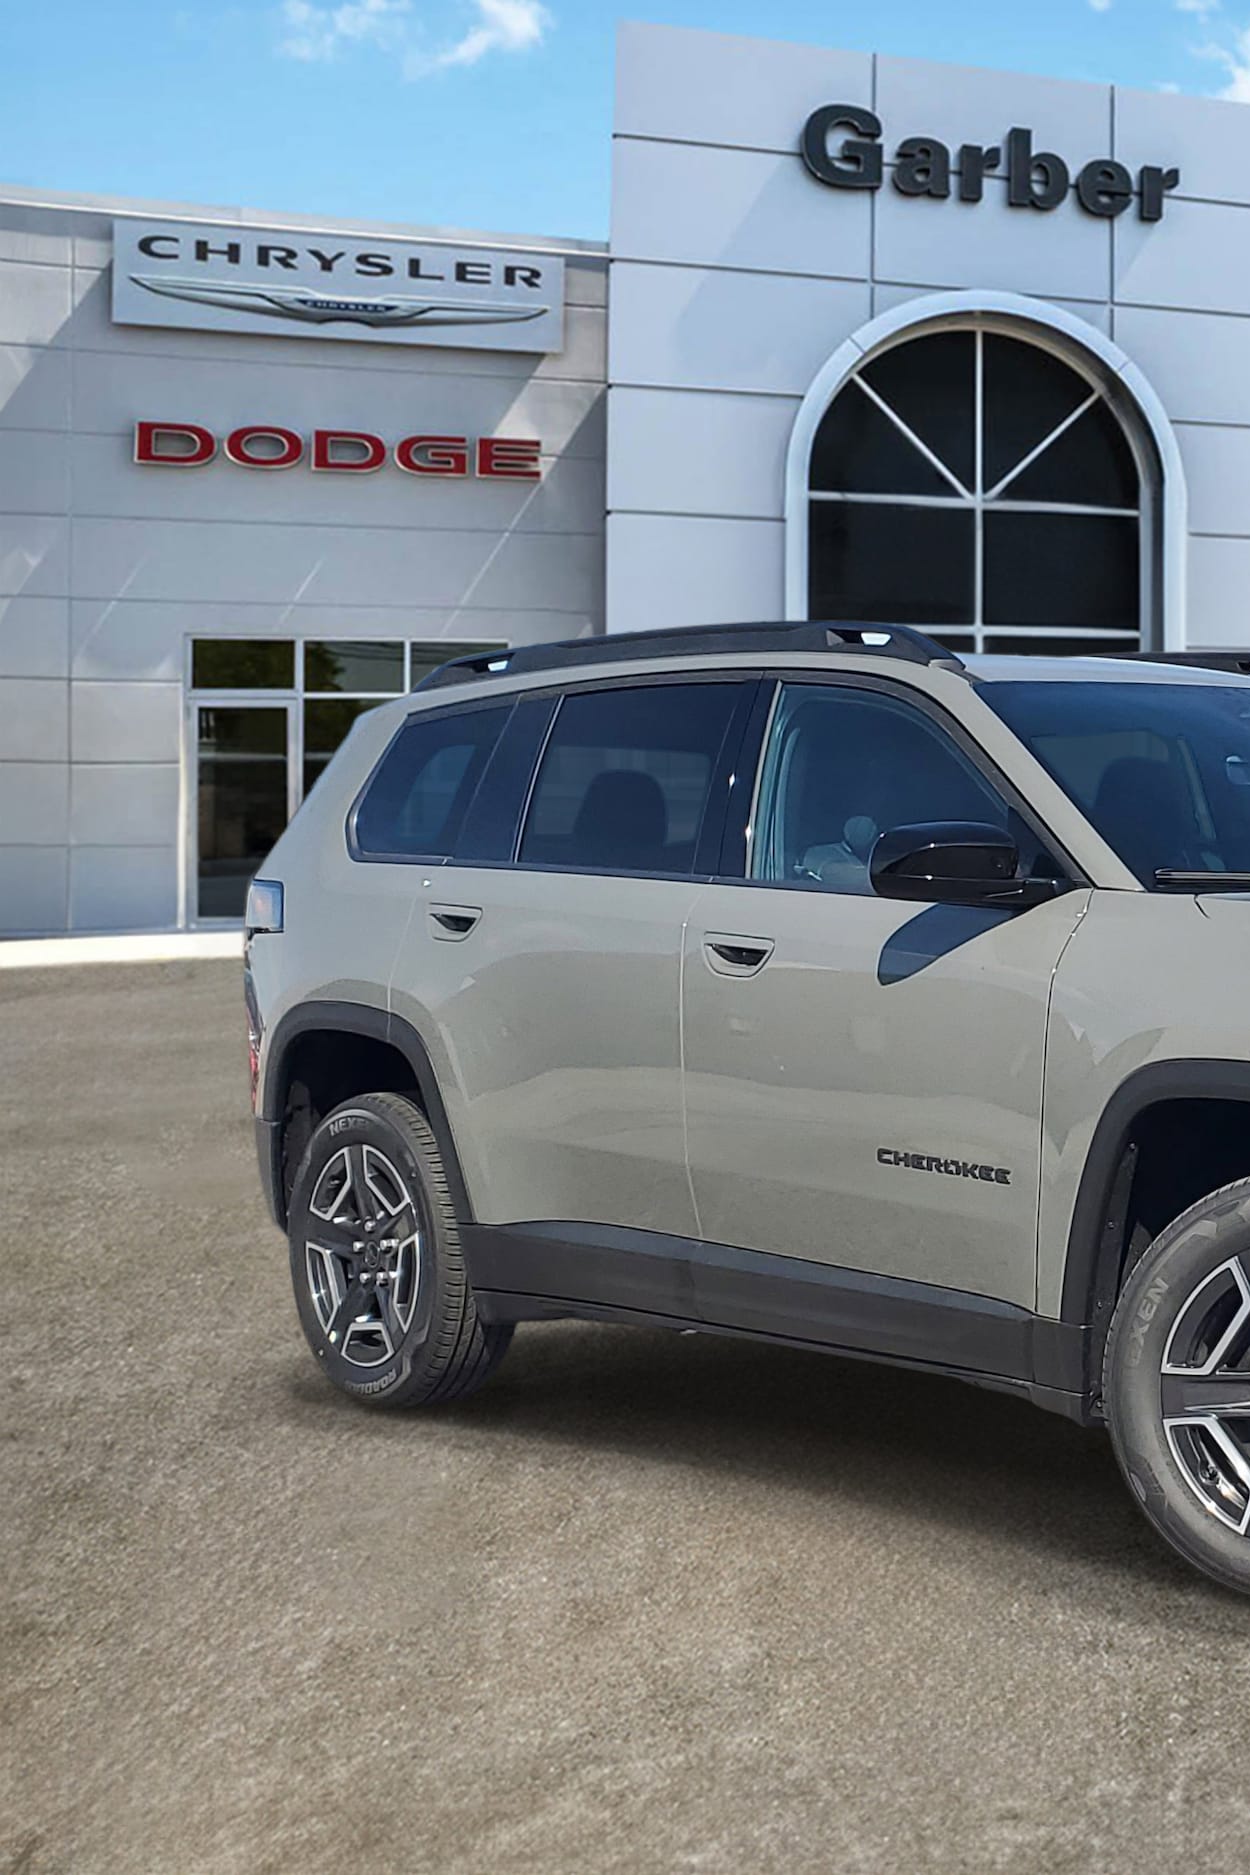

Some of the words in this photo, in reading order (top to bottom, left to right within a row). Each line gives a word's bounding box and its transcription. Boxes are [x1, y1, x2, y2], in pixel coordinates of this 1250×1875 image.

[801, 104, 1180, 222] Garber
[137, 236, 543, 288] CHRYSLER
[133, 420, 543, 479] DODGE
[877, 1148, 1011, 1184] CHEROKEE
